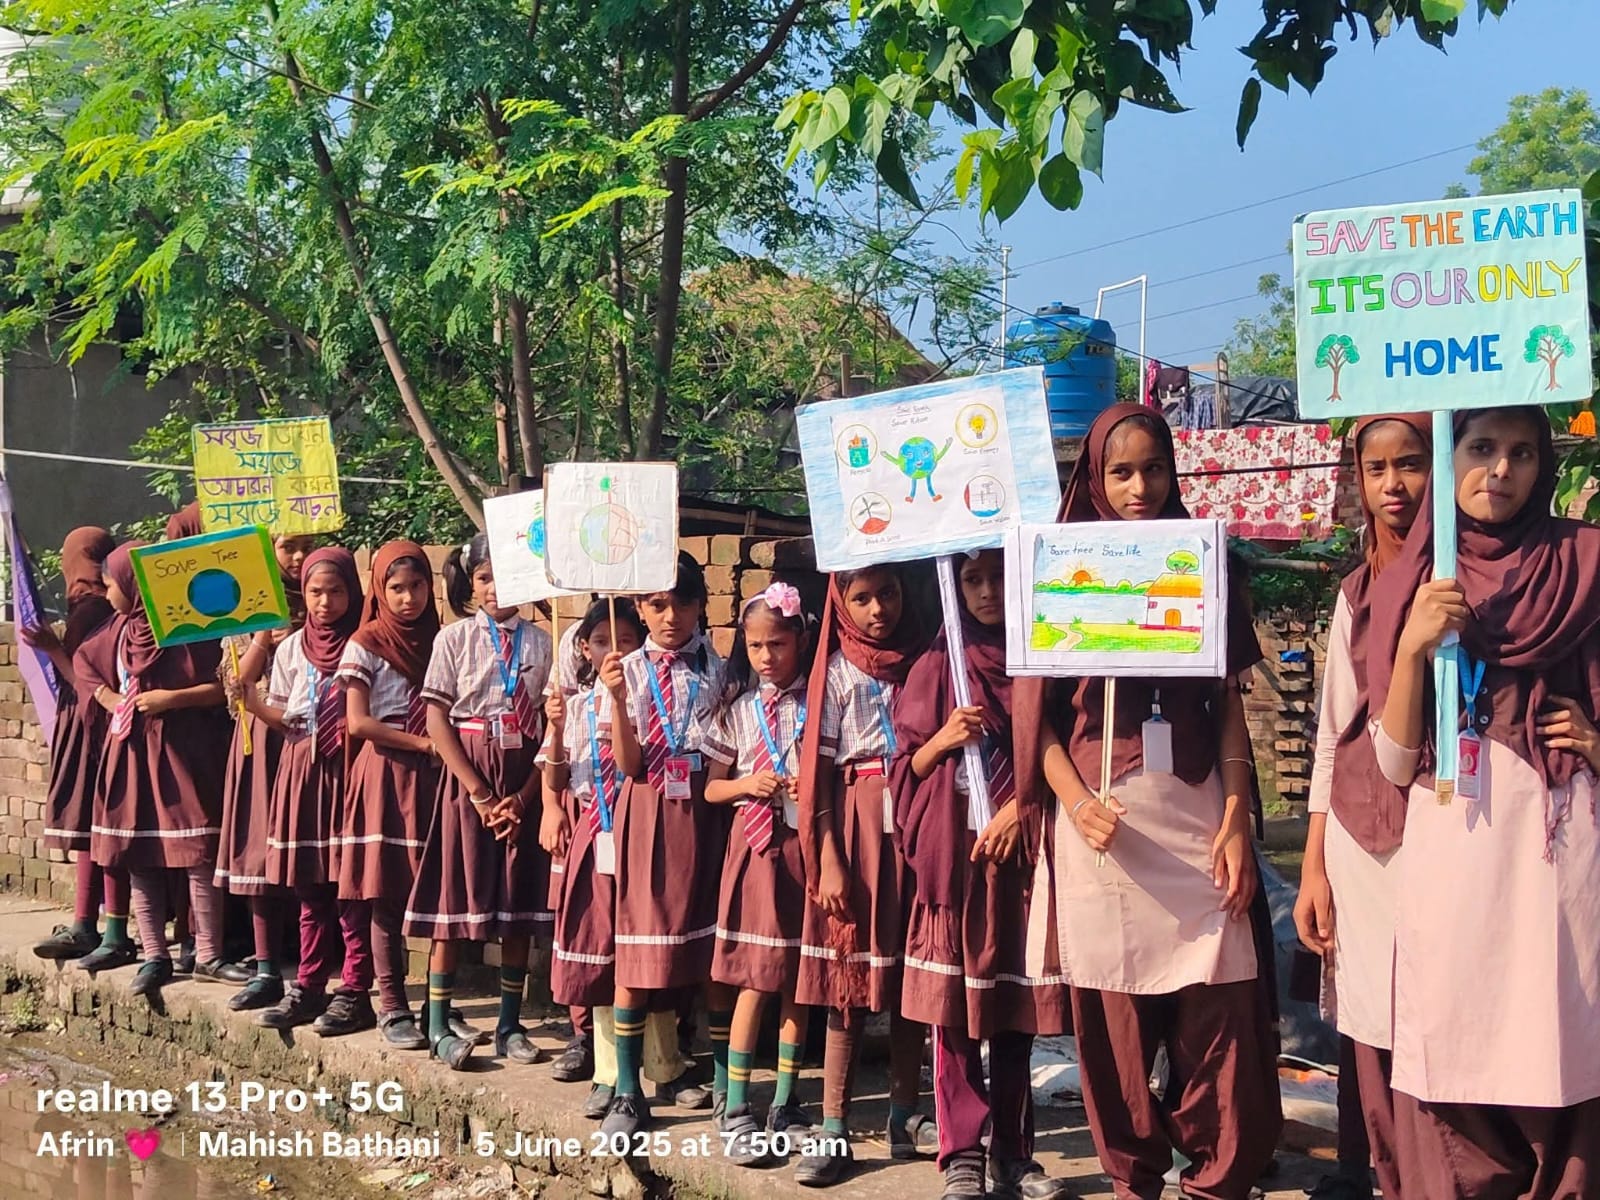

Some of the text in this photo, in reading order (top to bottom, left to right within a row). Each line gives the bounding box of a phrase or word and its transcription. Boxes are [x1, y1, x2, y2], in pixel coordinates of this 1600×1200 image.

[1306, 201, 1577, 256] SAVE THE EARTH
[1308, 257, 1582, 315] ITS OUR ONLY
[1385, 334, 1503, 378] HOME
[1072, 541, 1093, 554] tree
